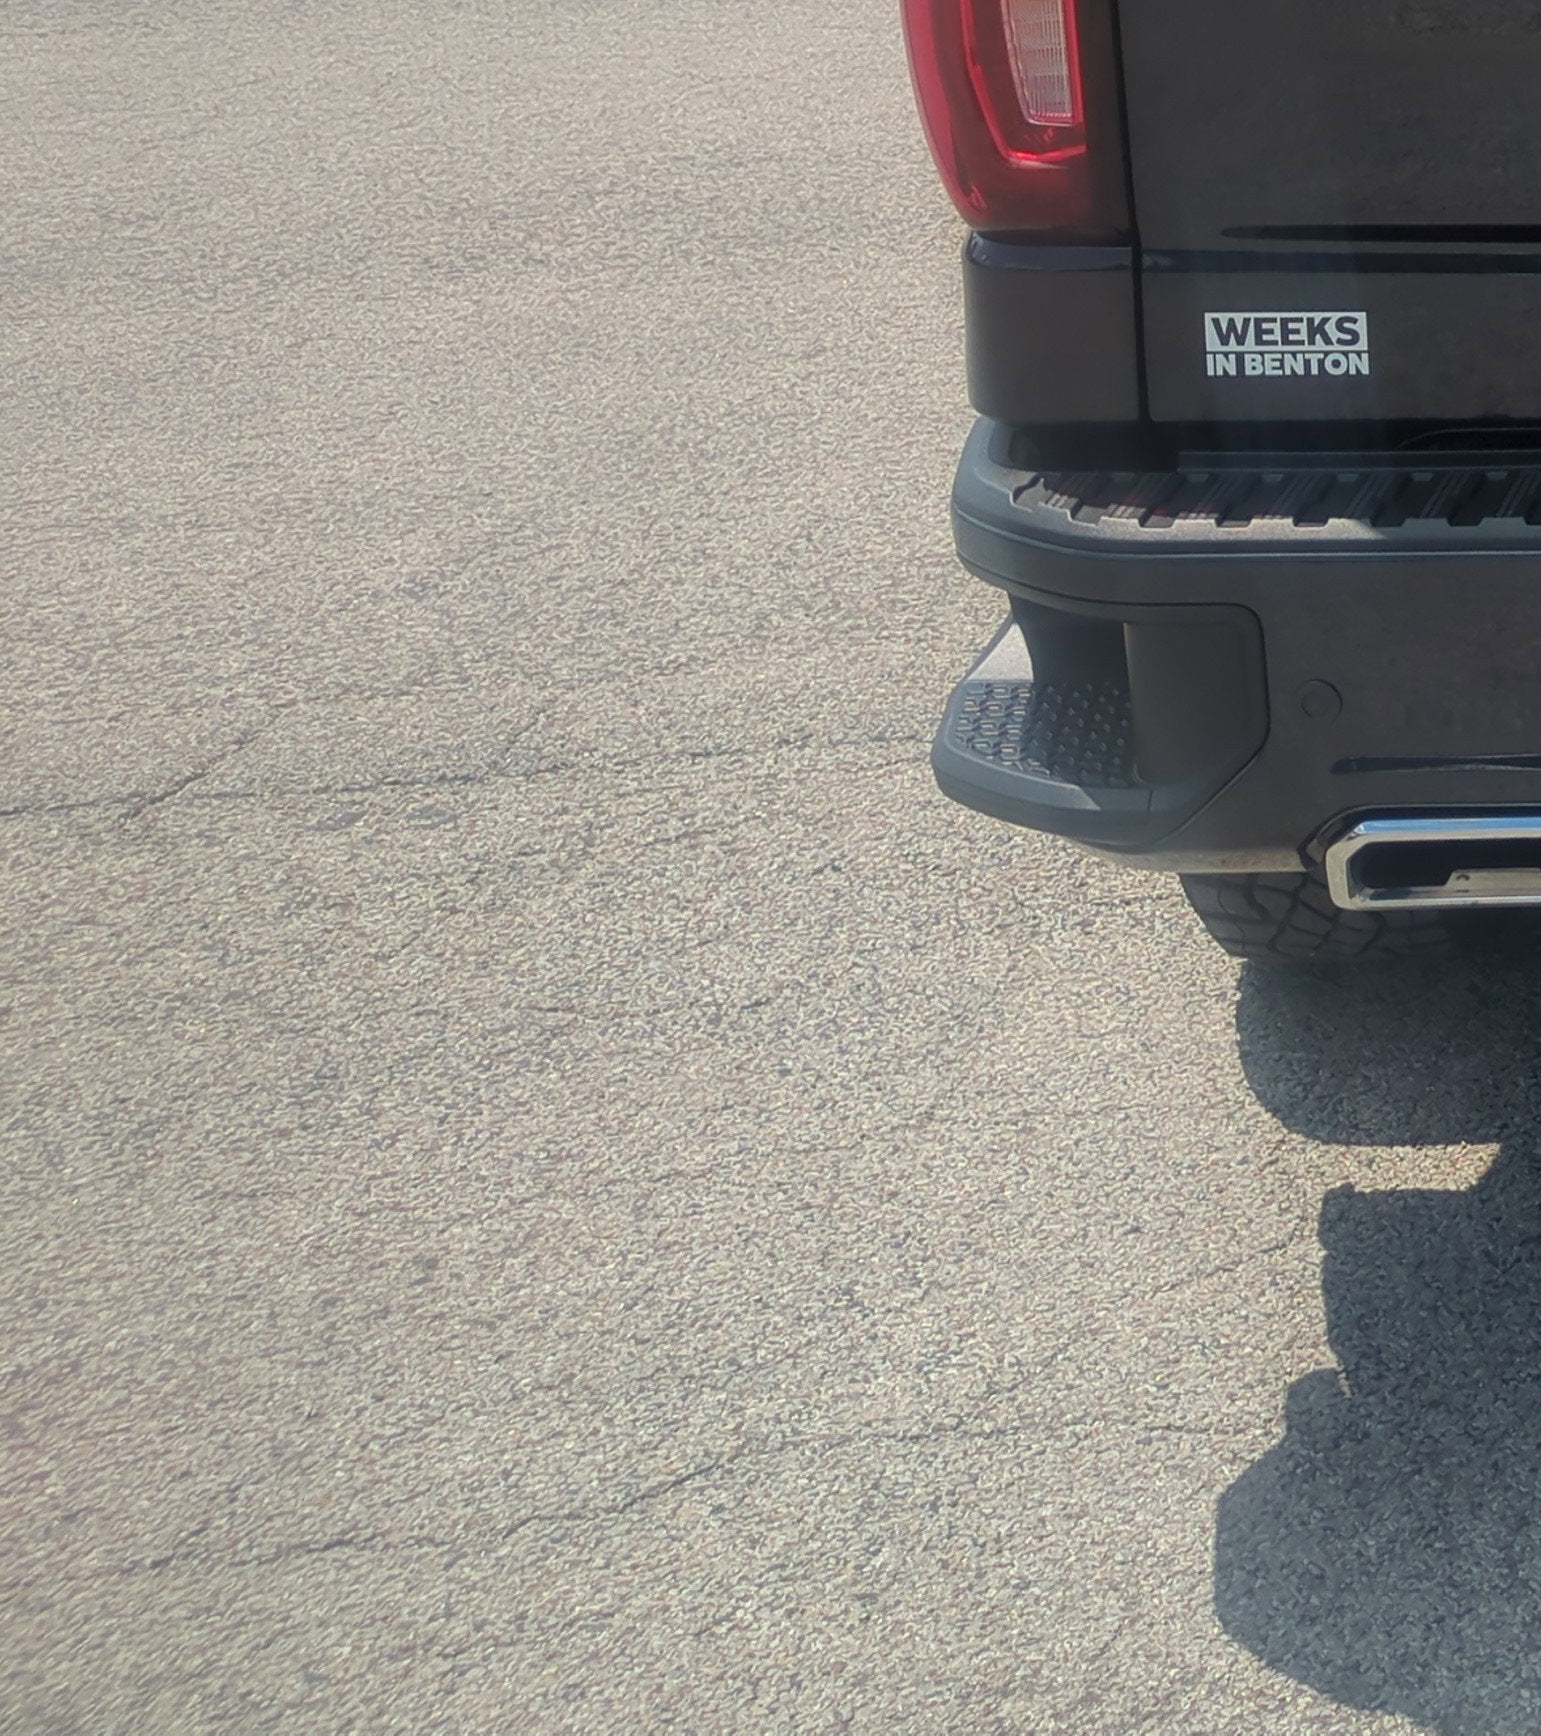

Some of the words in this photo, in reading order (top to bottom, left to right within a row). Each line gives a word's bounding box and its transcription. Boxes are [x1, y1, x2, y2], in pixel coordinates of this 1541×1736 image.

[1210, 315, 1361, 348] WEEKS
[1206, 353, 1238, 376] IN
[1244, 352, 1370, 376] BENTON
